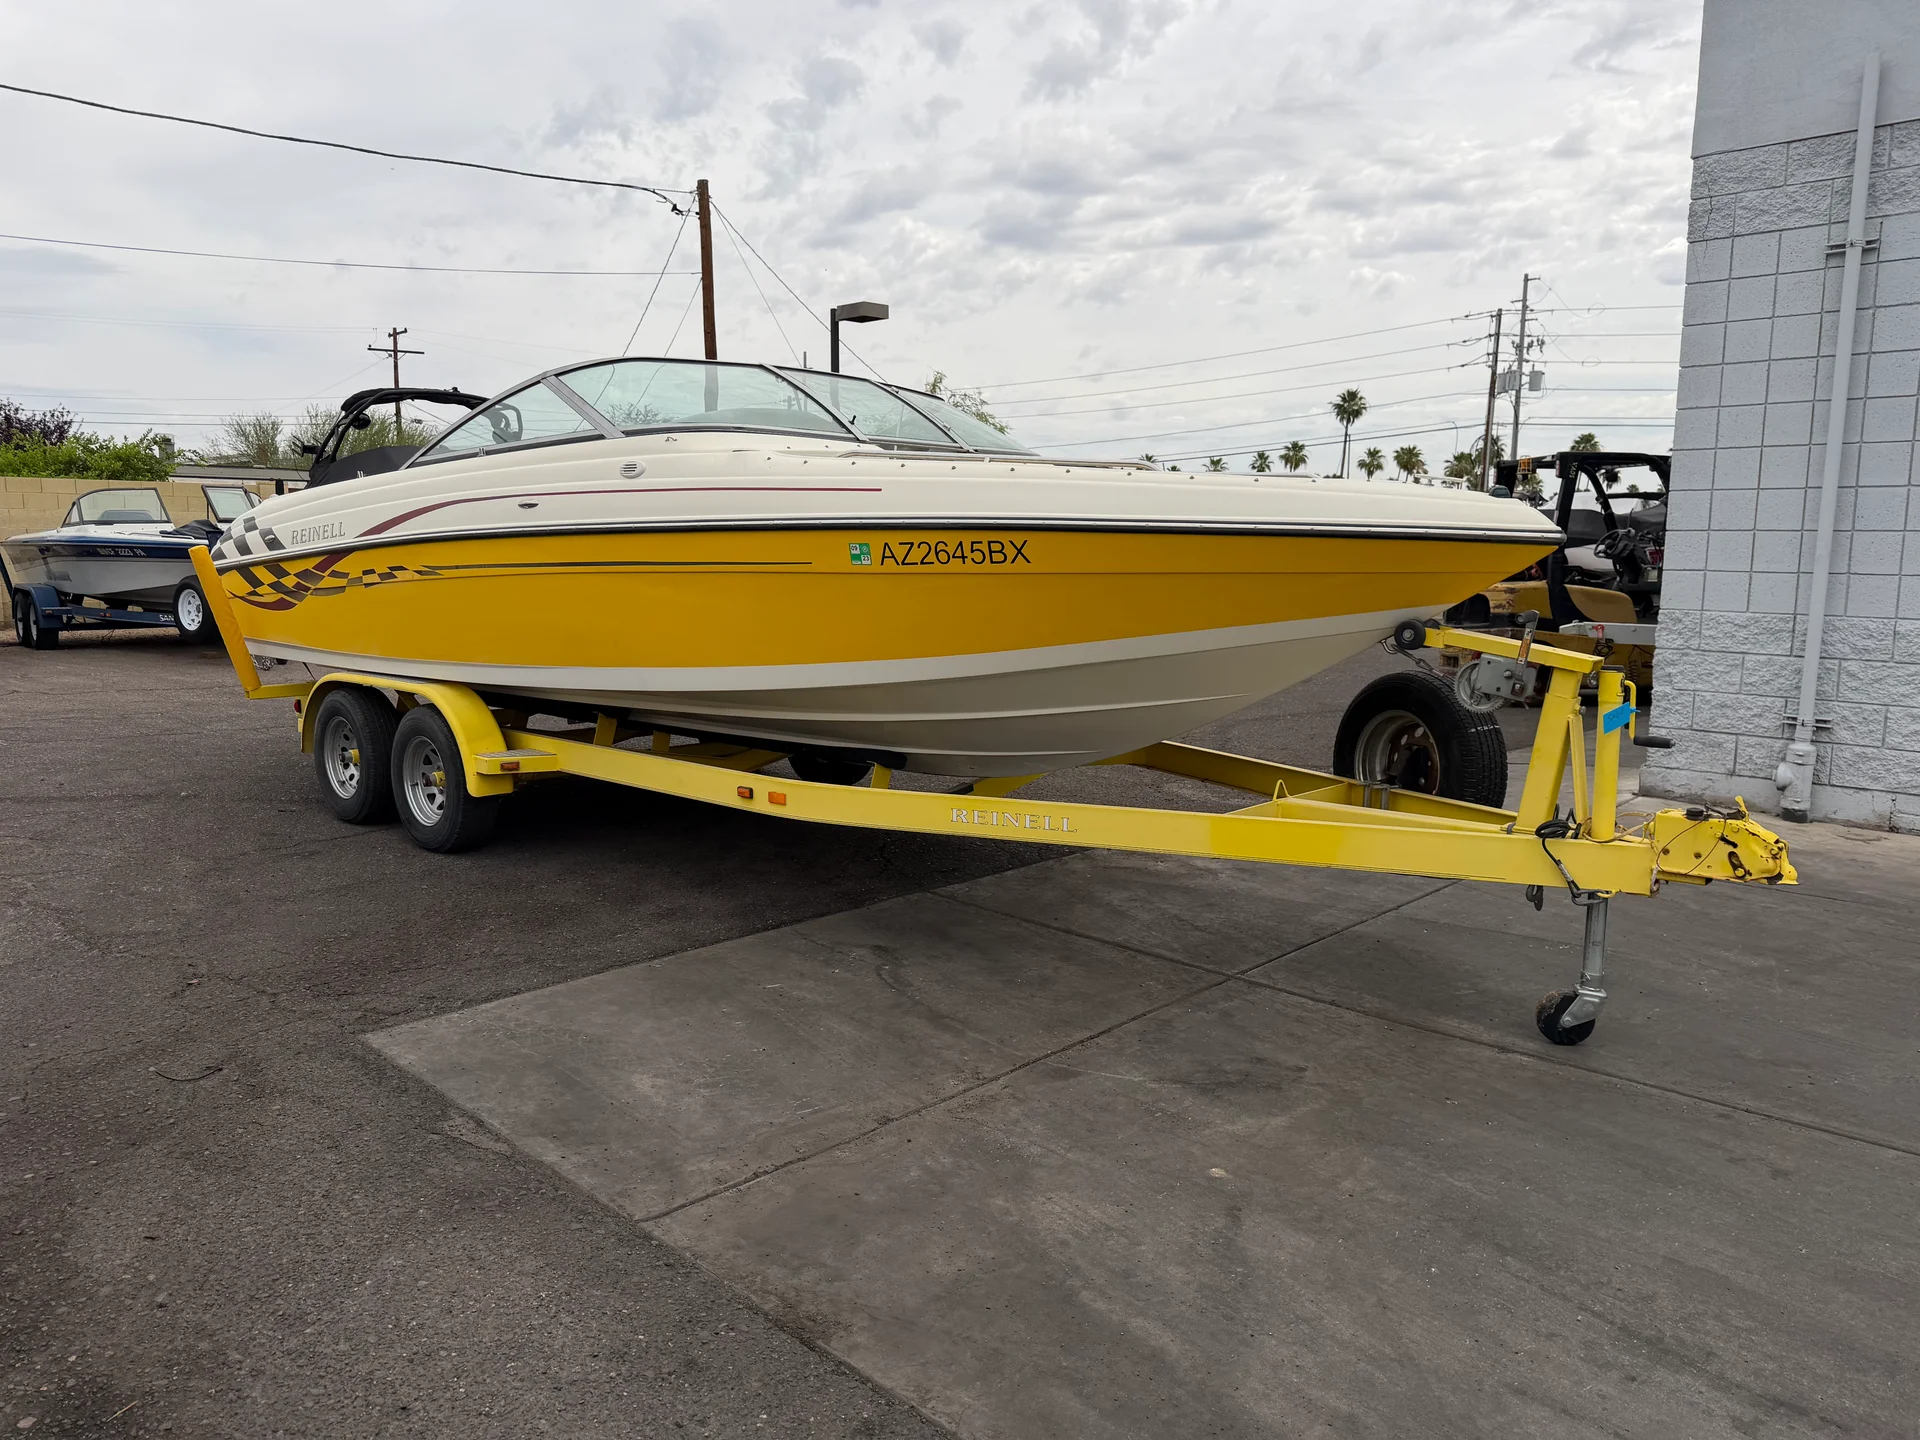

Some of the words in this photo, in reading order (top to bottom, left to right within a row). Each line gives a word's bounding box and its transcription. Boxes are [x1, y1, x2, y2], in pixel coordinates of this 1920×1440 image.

[291, 521, 346, 545] REINELL
[880, 539, 1032, 566] AZ2645BX
[951, 807, 1078, 833] REINELL
